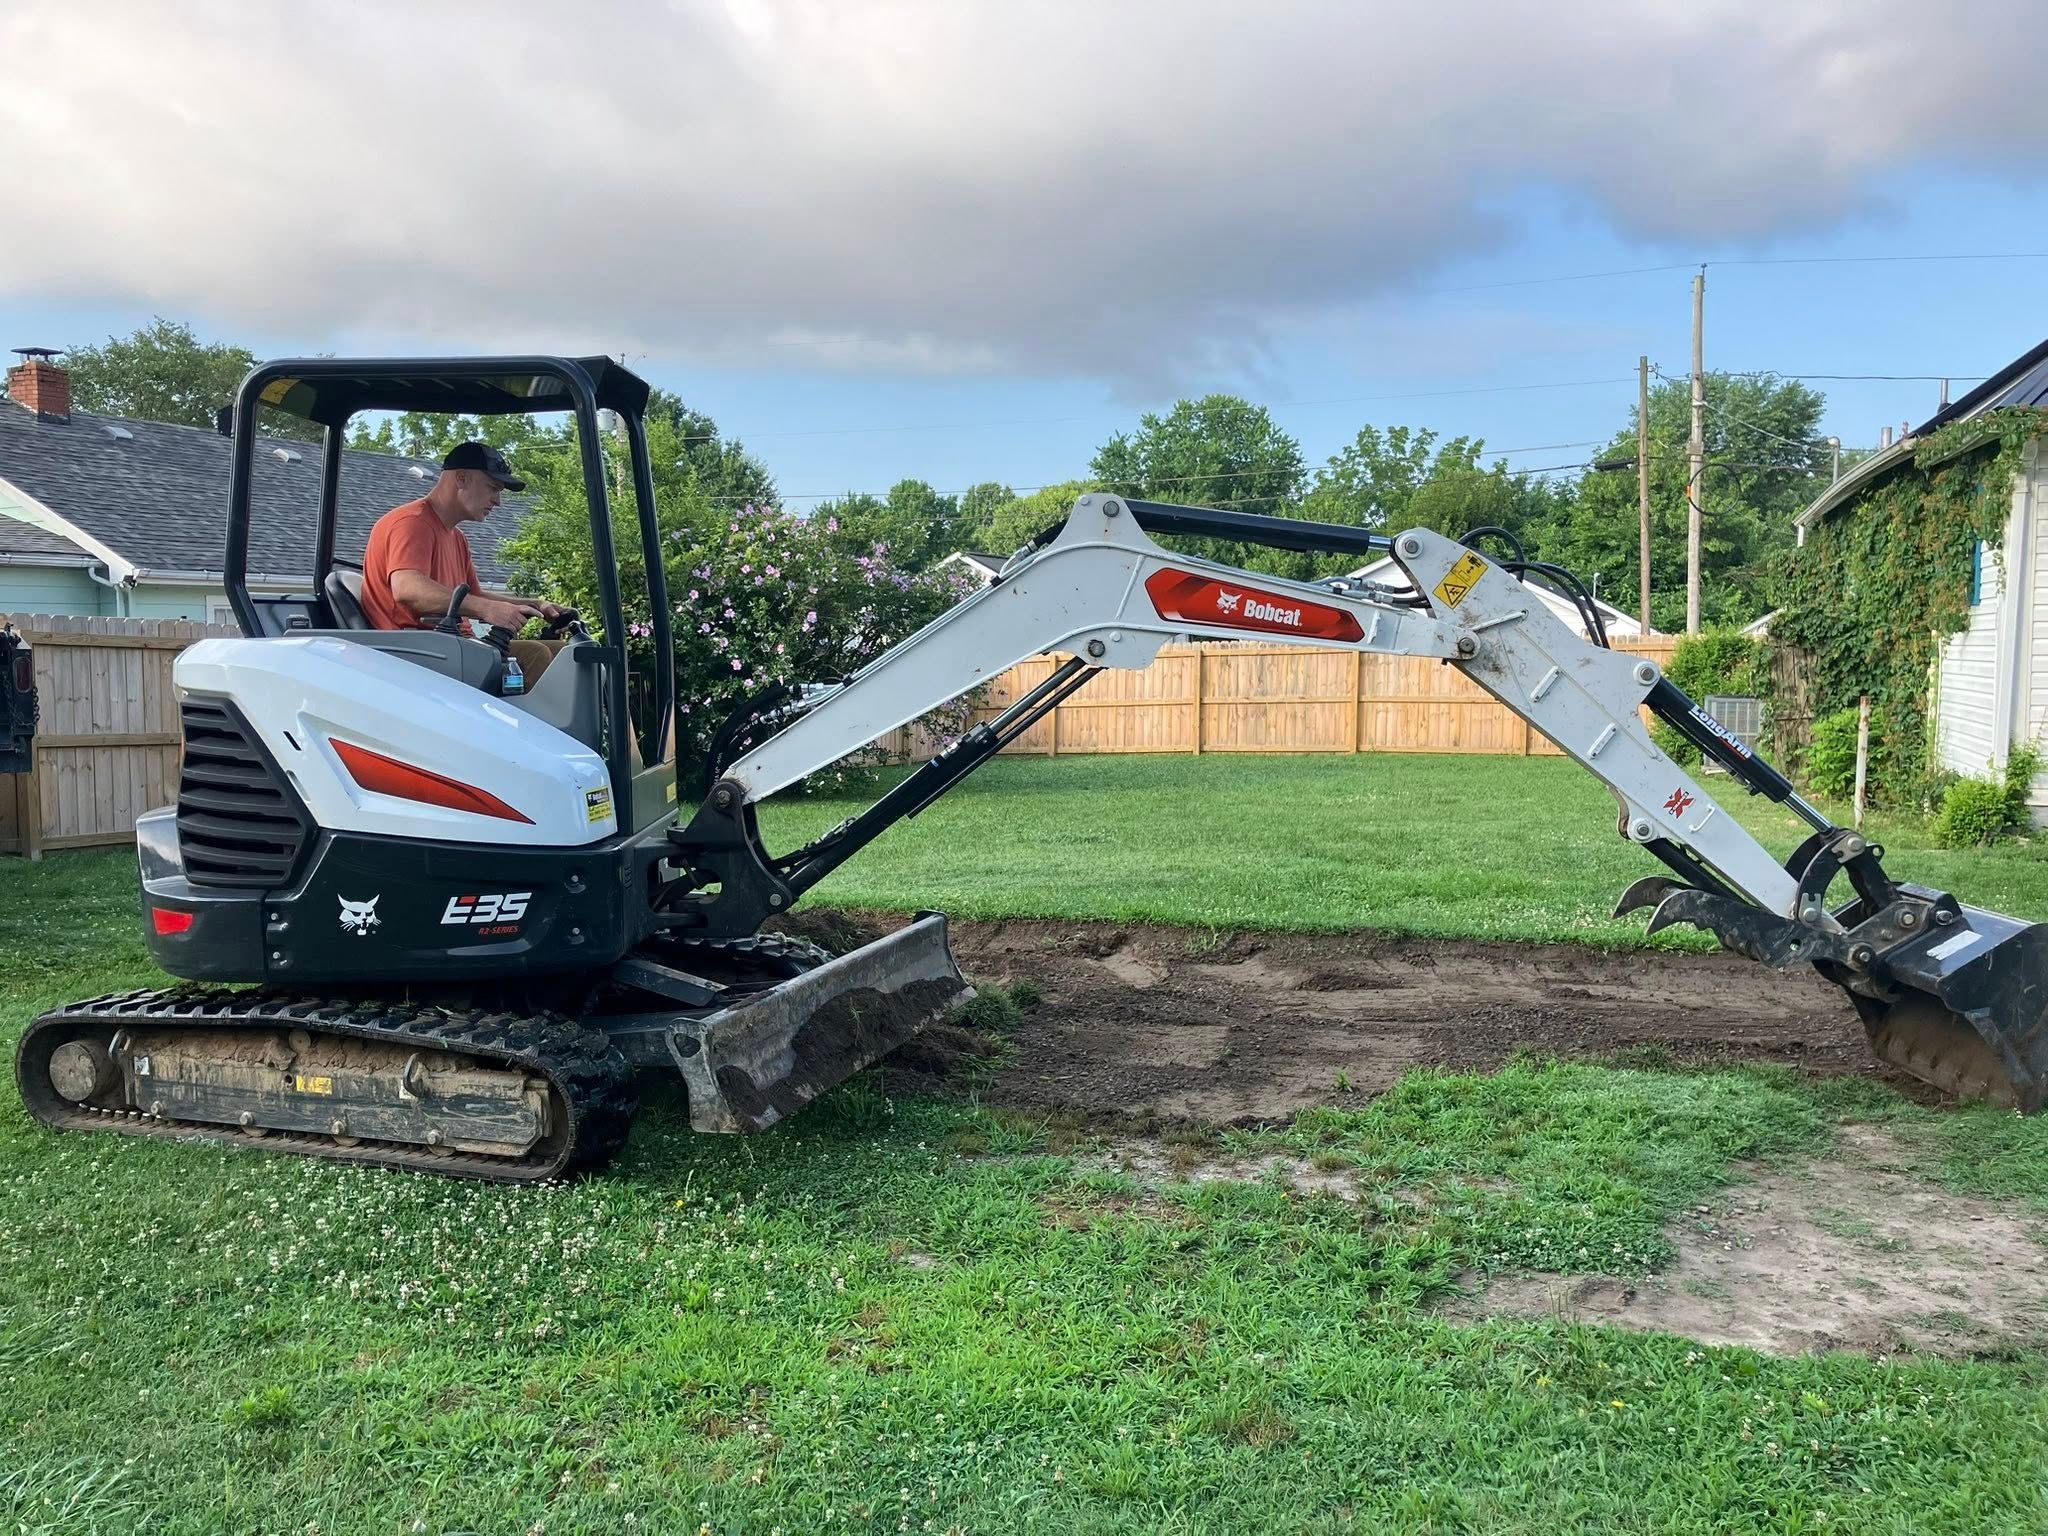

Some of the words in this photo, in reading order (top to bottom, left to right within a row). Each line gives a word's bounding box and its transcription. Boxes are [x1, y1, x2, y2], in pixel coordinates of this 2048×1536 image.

[1244, 600, 1301, 626] Bobcat
[1690, 704, 1751, 758] LongArm
[440, 892, 532, 924] E35
